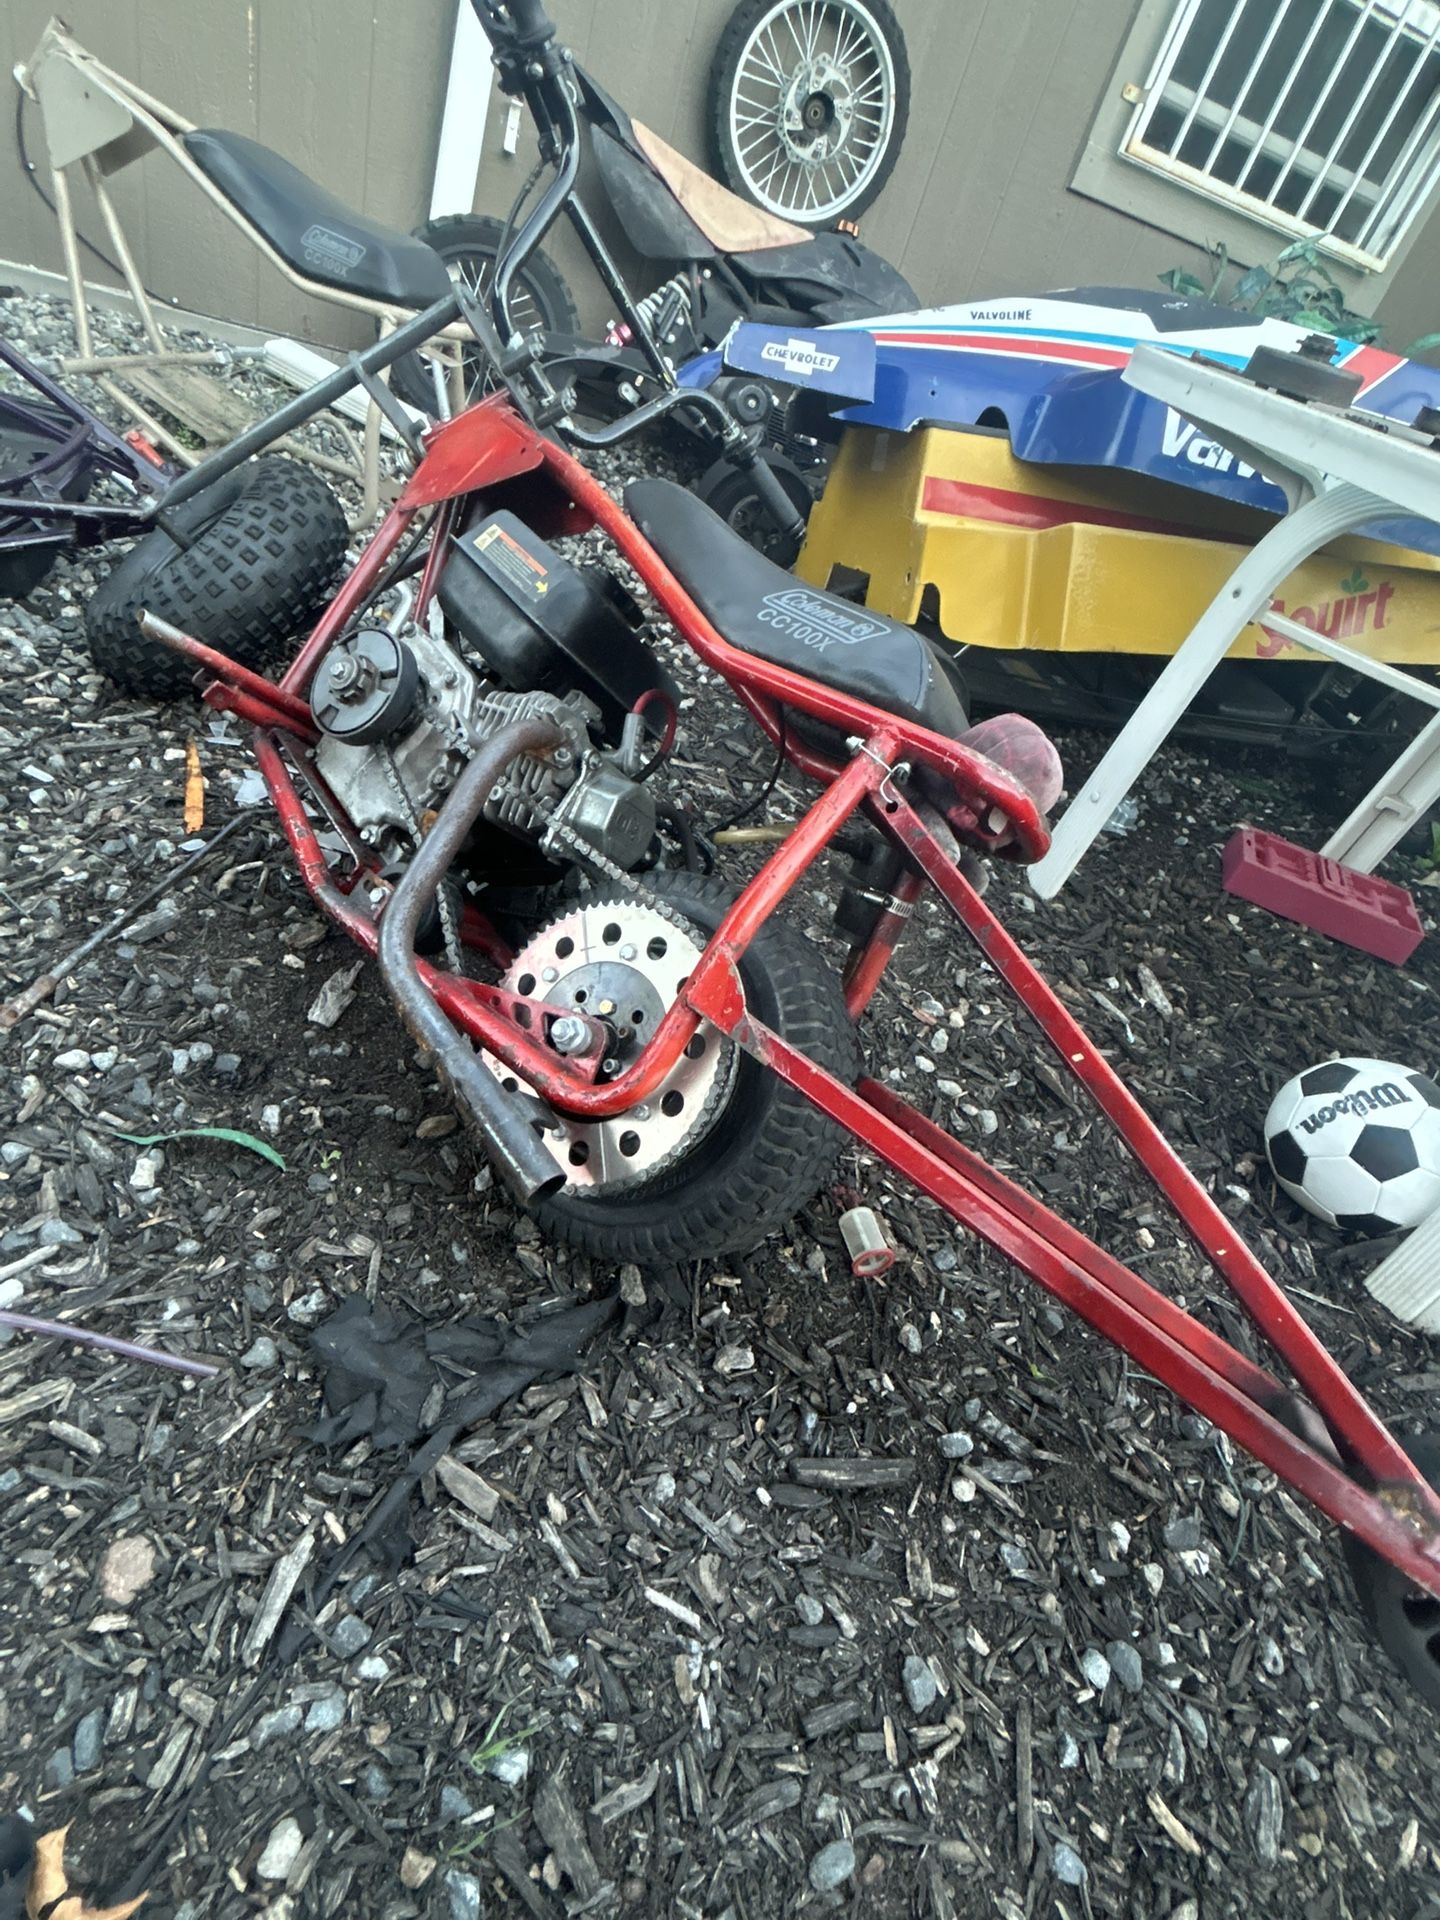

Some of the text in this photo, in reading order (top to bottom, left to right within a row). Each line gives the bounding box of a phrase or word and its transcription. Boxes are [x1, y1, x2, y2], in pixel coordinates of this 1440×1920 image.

[304, 248, 349, 277] CC100X
[970, 309, 1032, 321] VALVOLINE
[766, 346, 835, 368] CHEVROLET
[780, 593, 855, 629] Coleman
[756, 608, 837, 653] CC100X
[1299, 1082, 1413, 1135] Wilson
